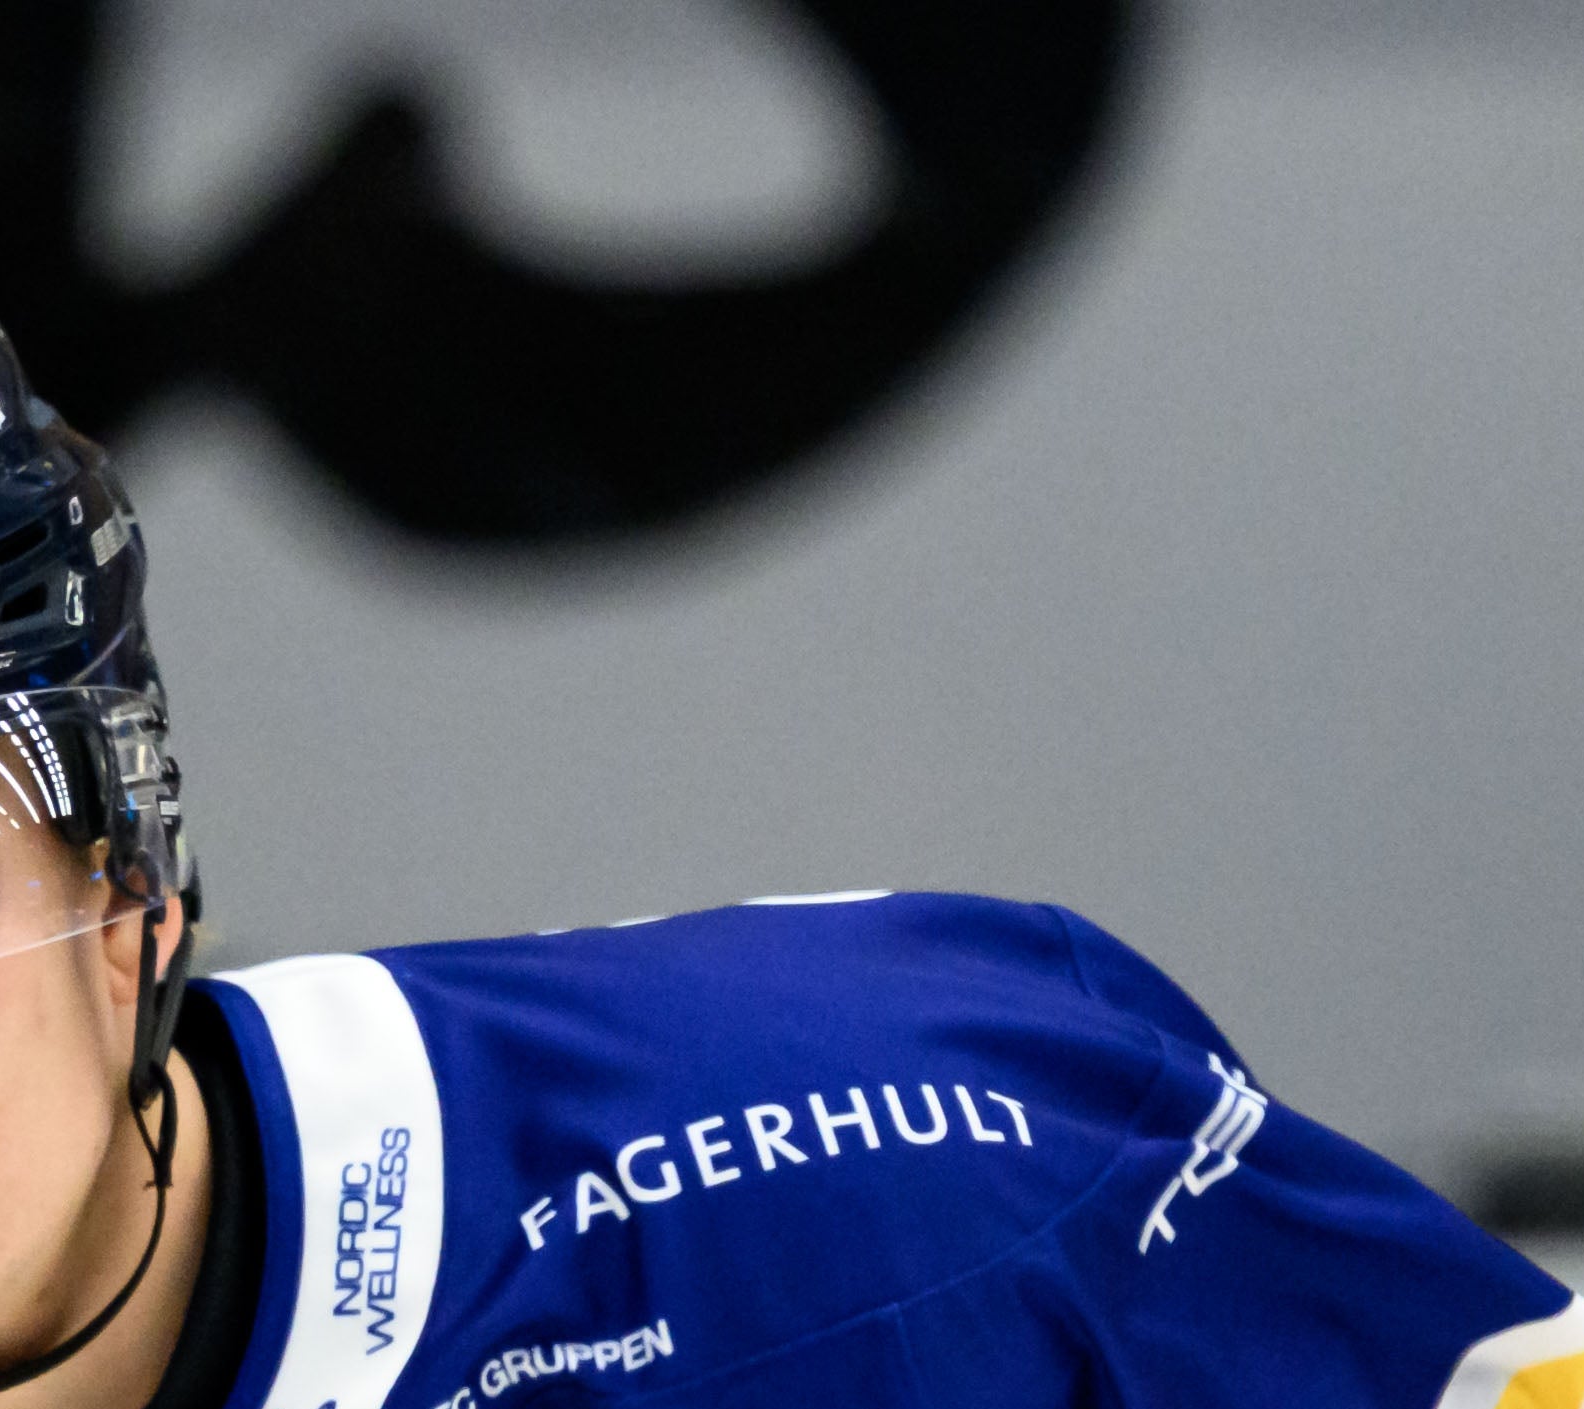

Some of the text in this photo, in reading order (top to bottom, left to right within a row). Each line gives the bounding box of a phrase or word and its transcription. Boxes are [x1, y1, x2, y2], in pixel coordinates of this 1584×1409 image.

[332, 1162, 372, 1317] NORDIC
[365, 1127, 411, 1356] WELLNESS
[520, 1083, 1033, 1251] FAGERHULT
[480, 1318, 674, 1398] GRUPPEN
